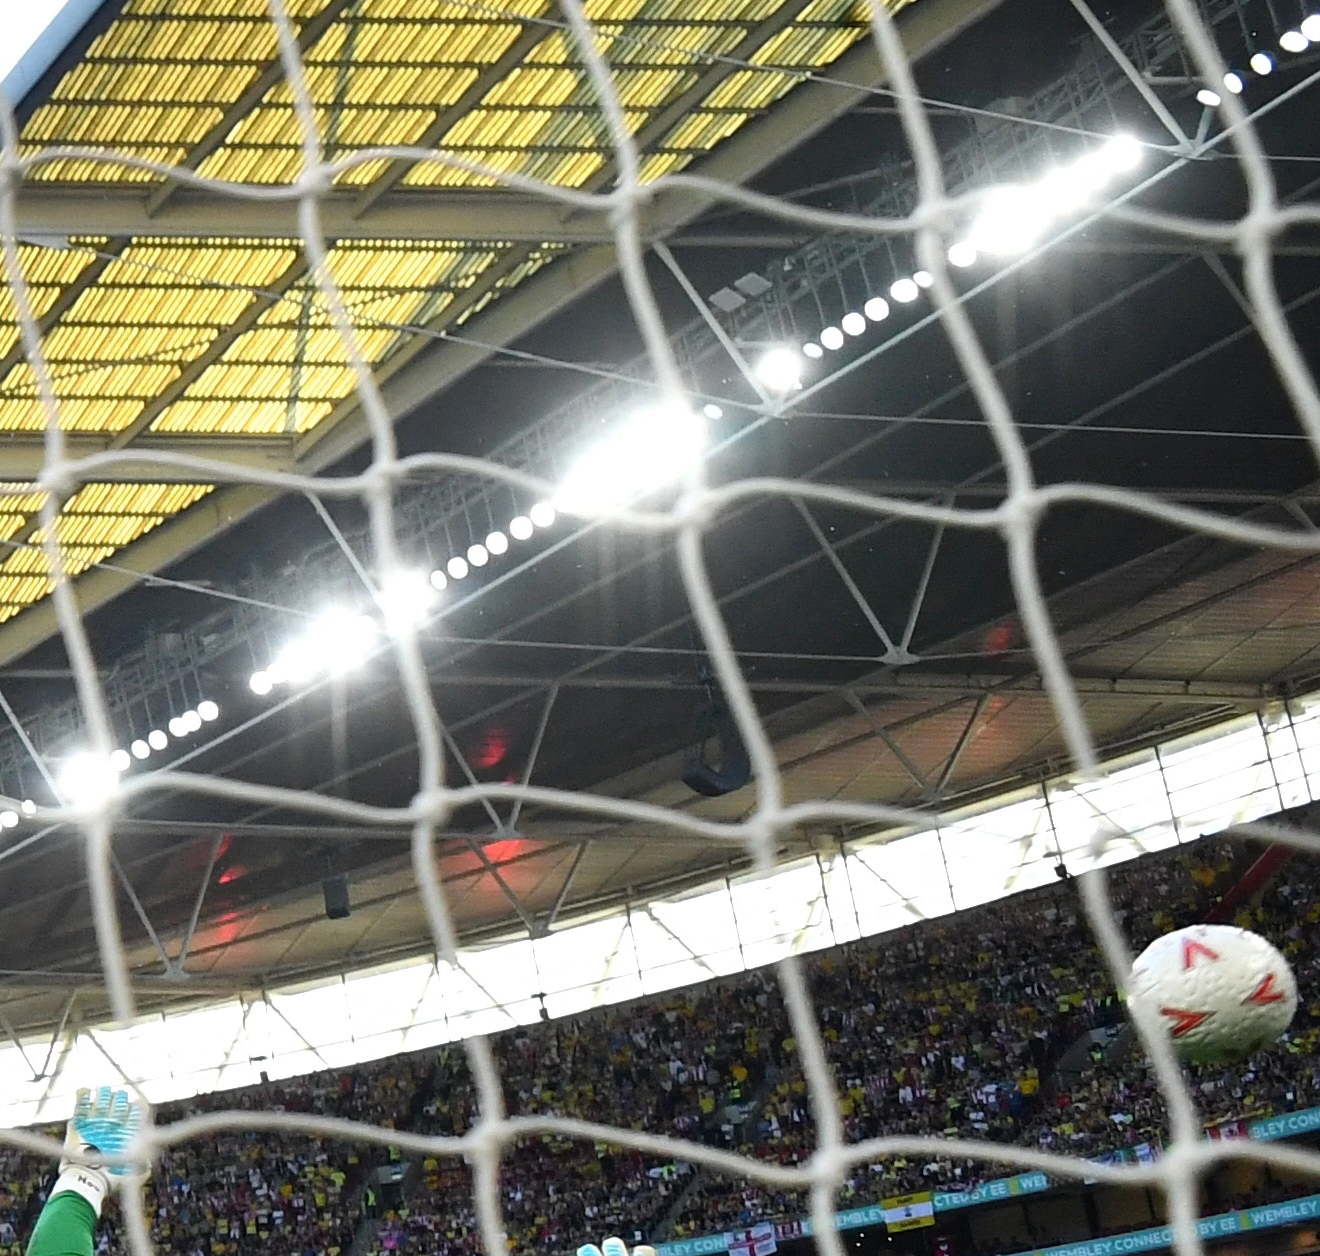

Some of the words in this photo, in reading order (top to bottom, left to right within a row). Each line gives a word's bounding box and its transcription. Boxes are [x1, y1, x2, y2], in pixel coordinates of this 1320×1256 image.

[837, 1208, 884, 1226] EMBLEY
[1251, 1201, 1318, 1224] WEMBLEY
[1200, 1220, 1219, 1236] BY
[1220, 1217, 1235, 1231] EE
